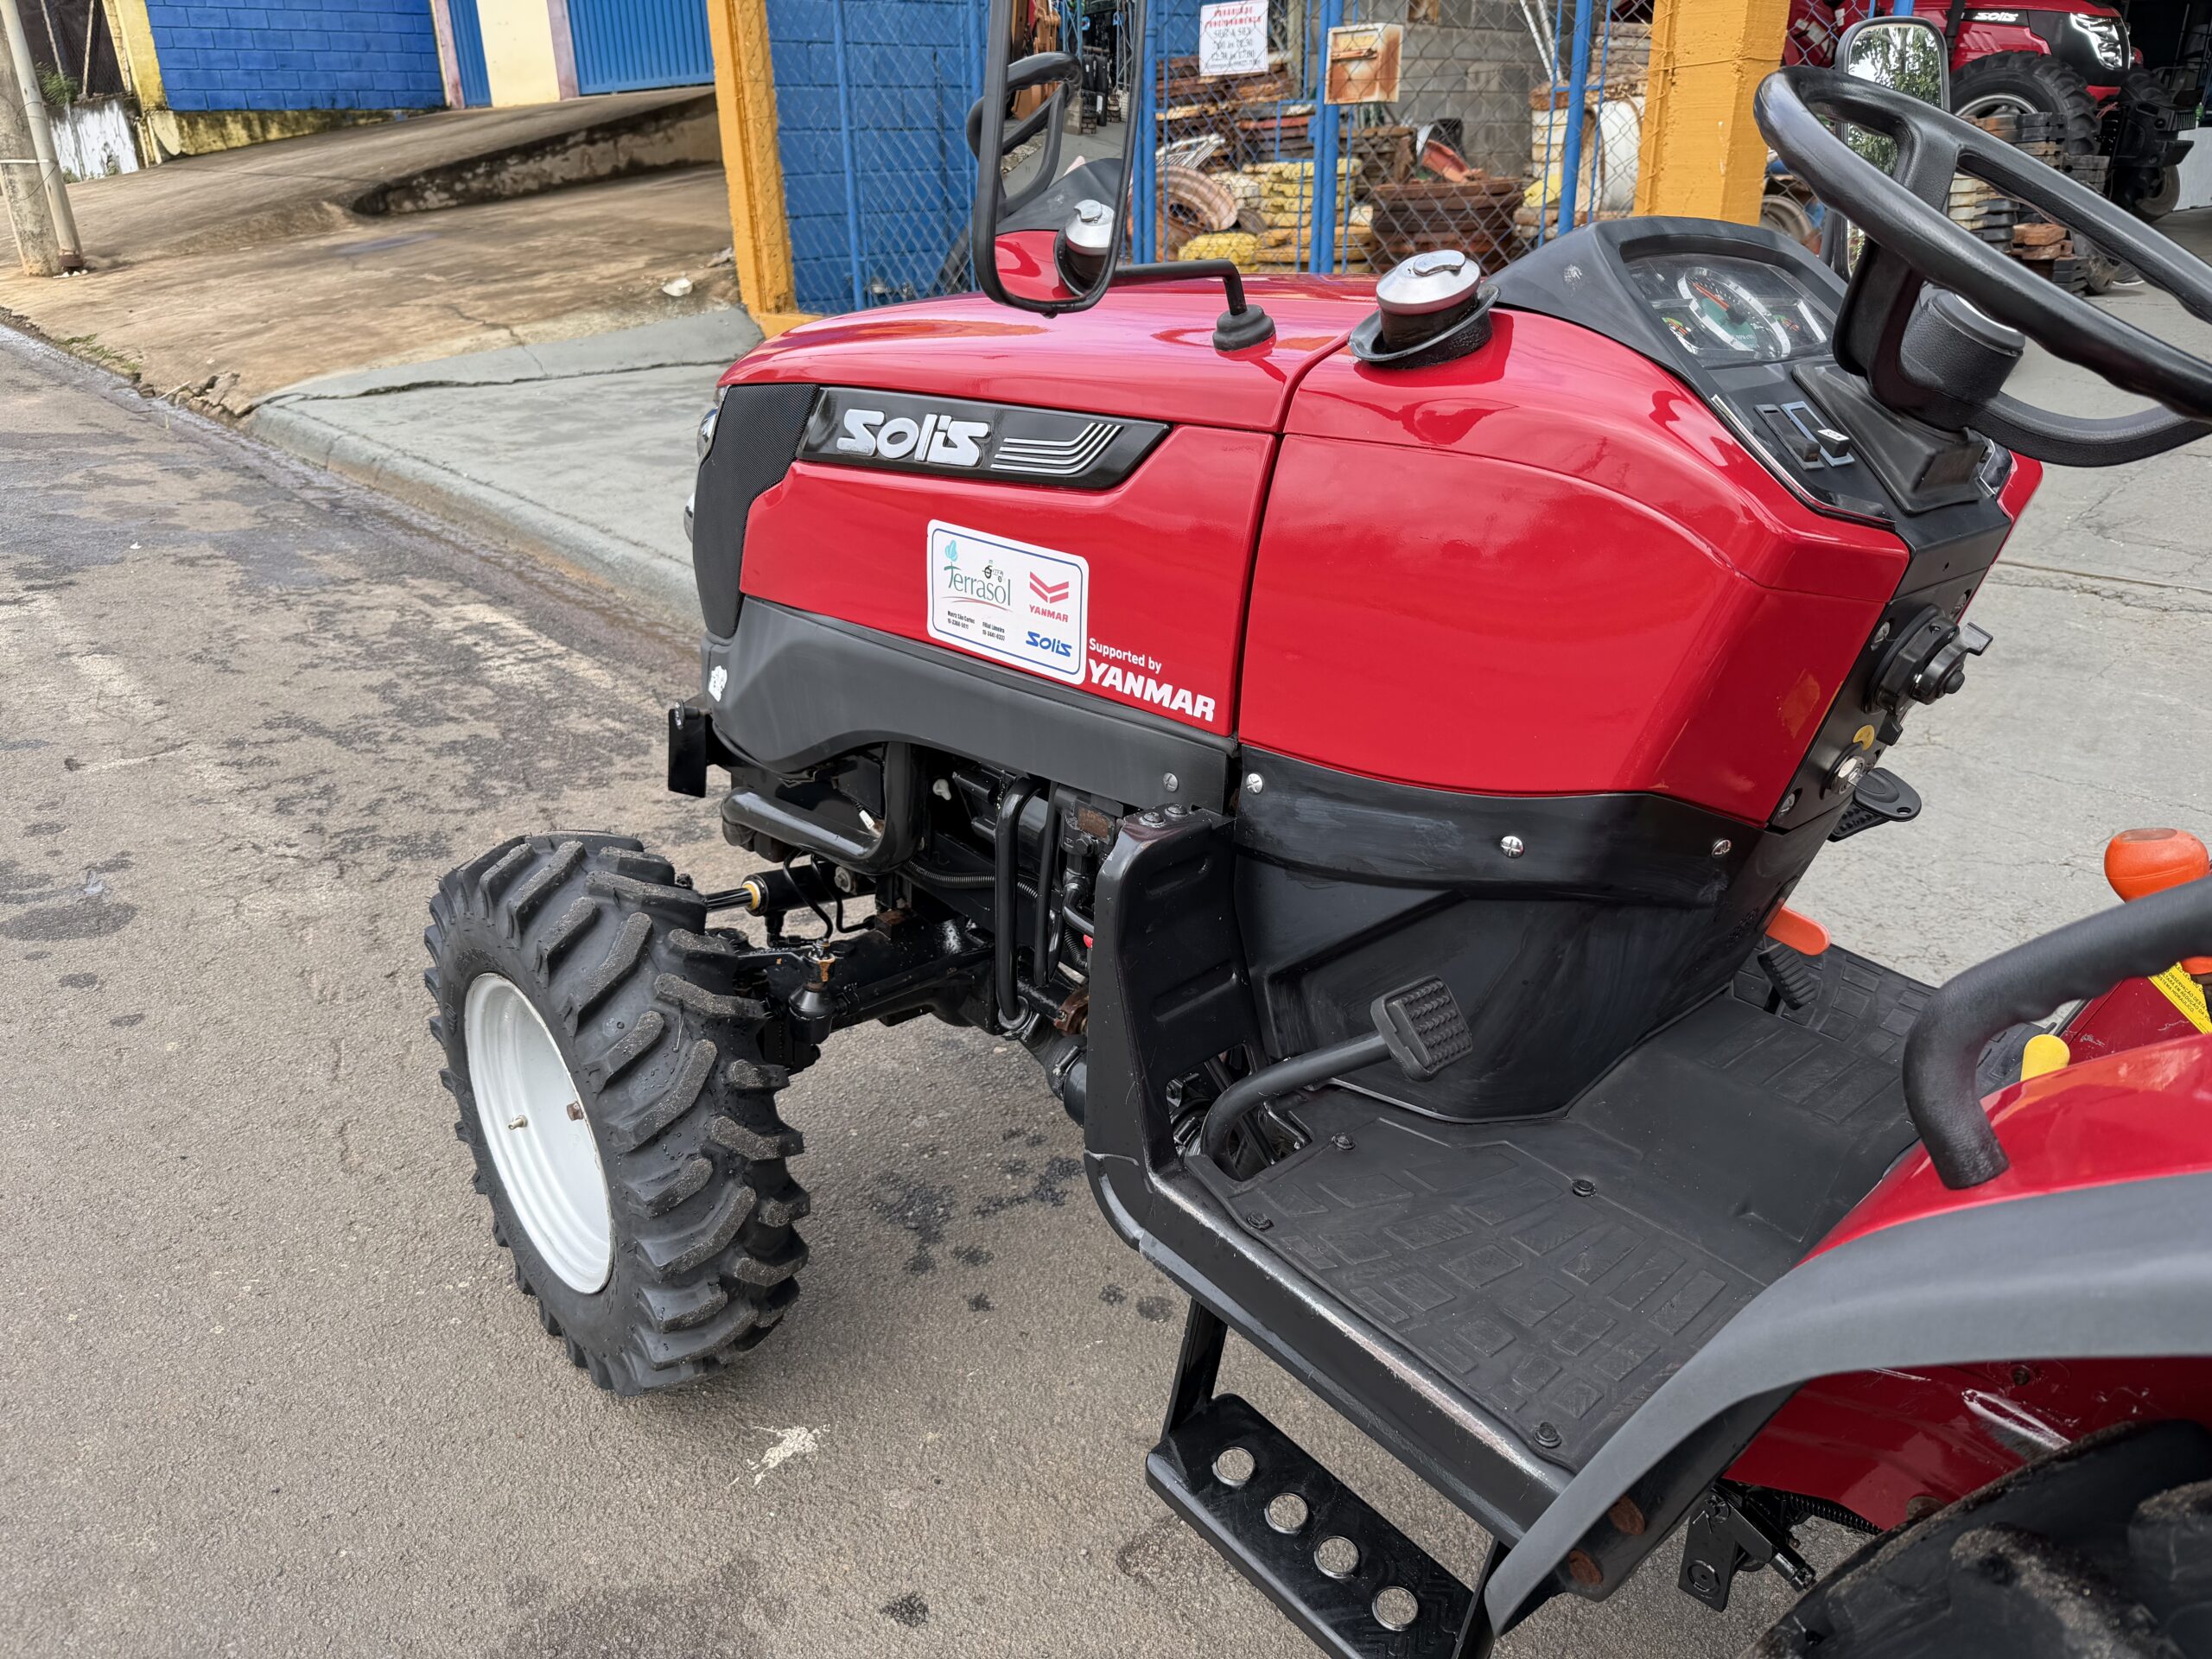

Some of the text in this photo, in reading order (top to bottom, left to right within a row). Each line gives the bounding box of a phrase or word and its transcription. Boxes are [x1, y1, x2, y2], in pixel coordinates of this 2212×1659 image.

[944, 562, 1011, 606] Terrasol
[1029, 604, 1069, 622] YANMAR
[1089, 638, 1162, 674] Supported by
[1088, 658, 1216, 722] YANMAR
[2168, 971, 2206, 1009] OBSERVAÇÃO DESTA
[2180, 991, 2199, 1010] REDUÇÃO
